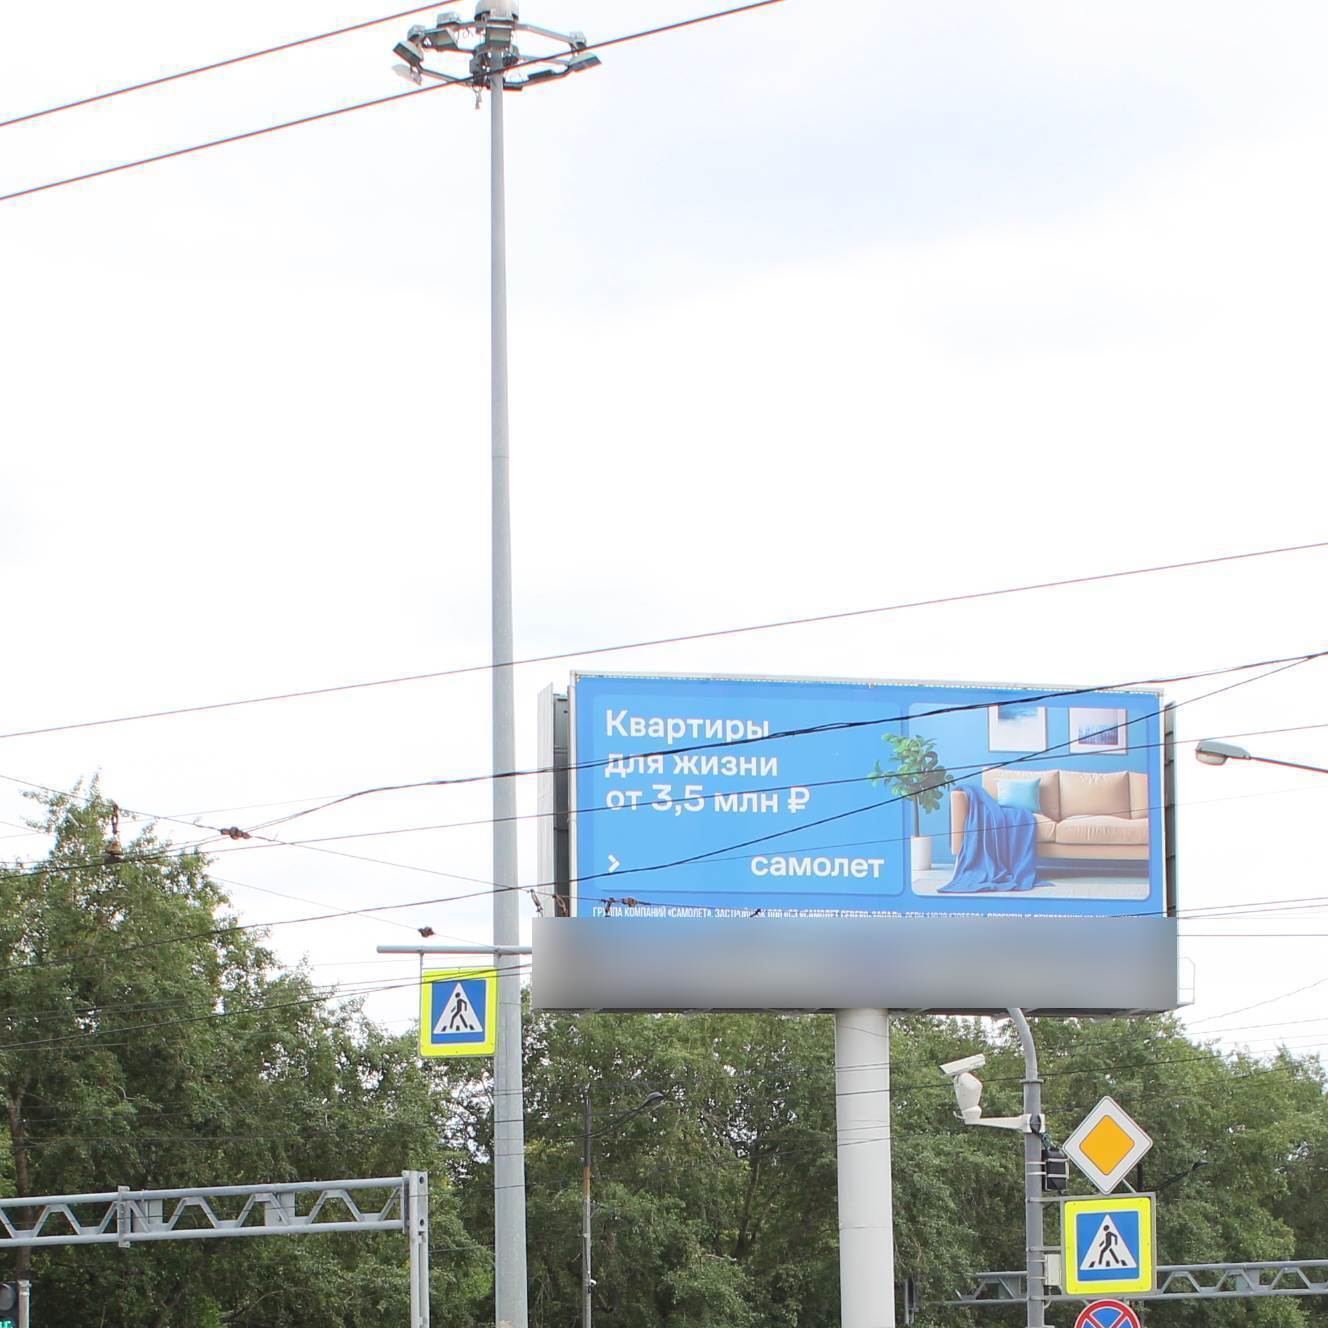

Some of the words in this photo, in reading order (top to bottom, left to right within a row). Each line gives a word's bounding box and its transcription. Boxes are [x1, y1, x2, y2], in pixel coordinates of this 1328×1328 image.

[605, 709, 769, 744] Квартиры
[604, 753, 664, 778] для
[673, 754, 778, 776] жизни
[606, 789, 642, 810] от
[652, 784, 705, 816] 3,5
[714, 791, 778, 813] млн
[750, 854, 885, 878] самолет
[624, 905, 666, 917] КОМПАНИЙ
